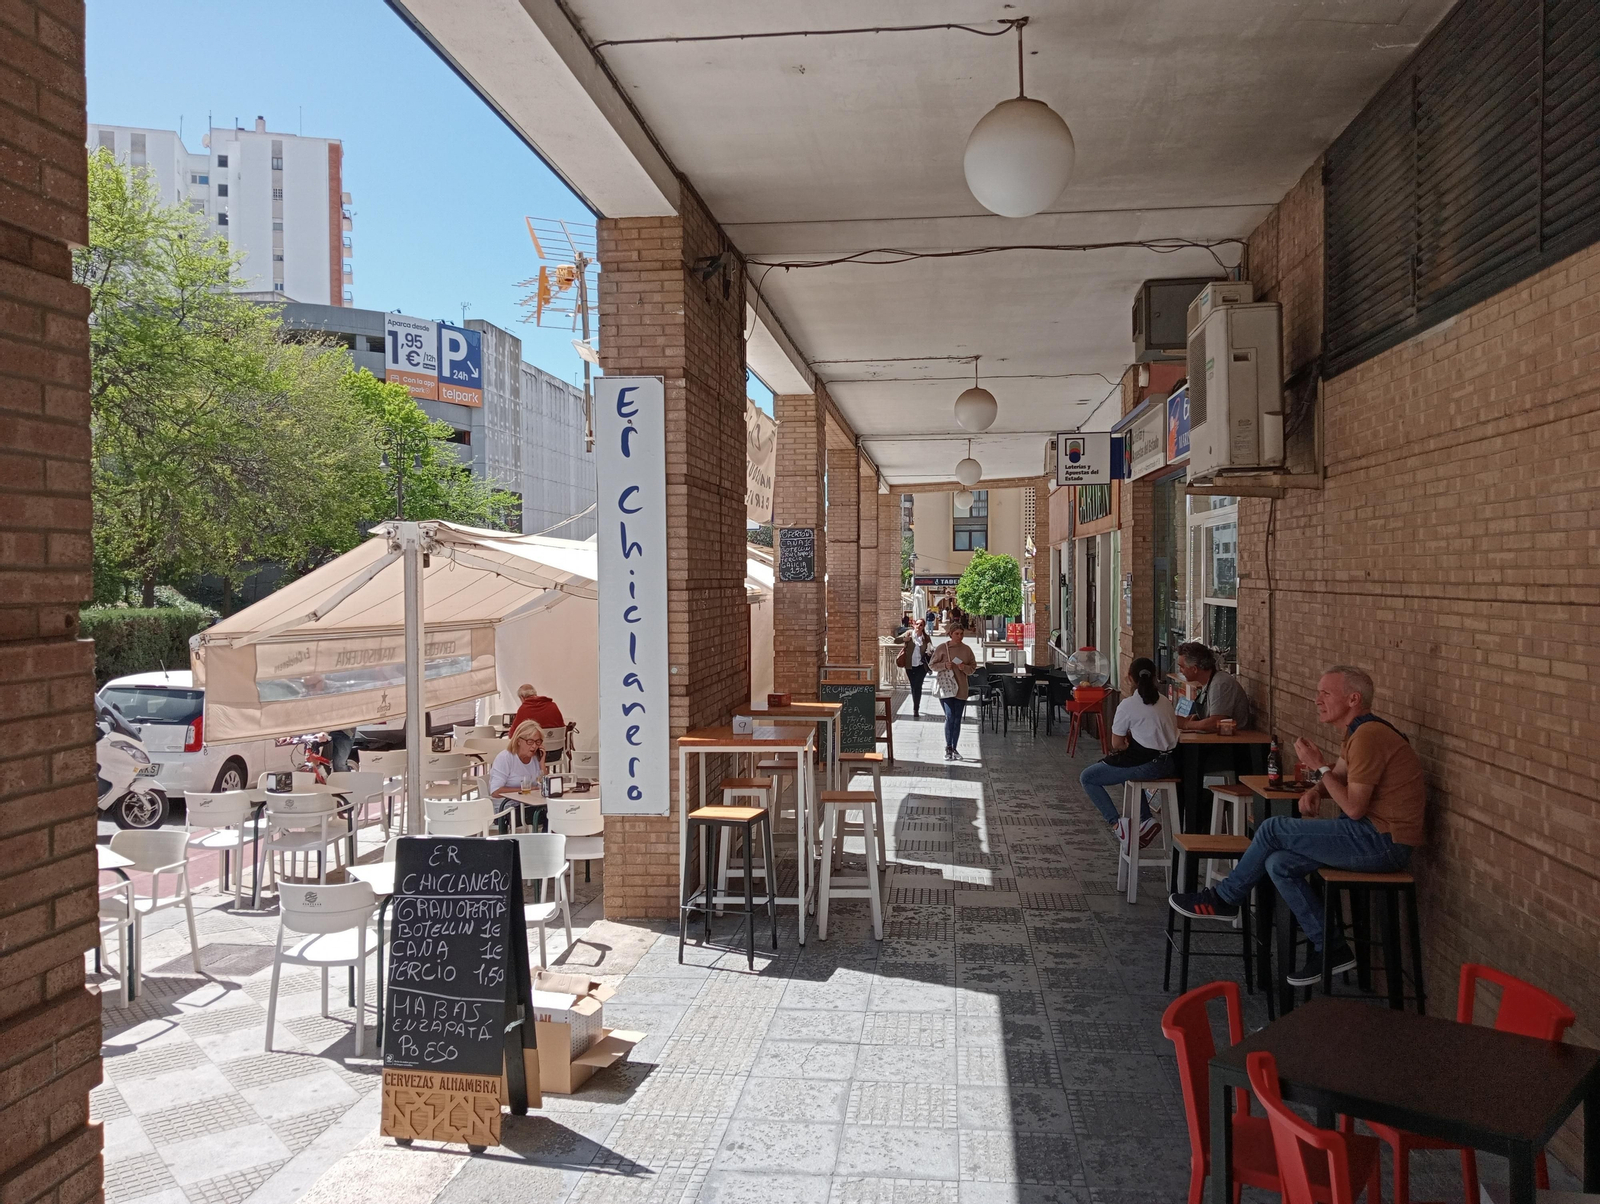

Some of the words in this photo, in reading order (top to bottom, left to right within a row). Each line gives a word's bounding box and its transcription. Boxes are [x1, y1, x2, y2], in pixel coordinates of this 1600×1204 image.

[387, 319, 411, 328] Aparca
[411, 323, 430, 332] desde
[441, 328, 468, 378] P
[402, 376, 416, 384] Con
[423, 380, 435, 388] app
[453, 370, 468, 381] 24h
[442, 387, 479, 404] telpark
[617, 485, 647, 801] Chiclanero
[738, 721, 746, 732] 9
[428, 844, 462, 867] ER
[402, 869, 511, 894] CHICLANERO
[397, 897, 453, 921] GRAN
[455, 900, 507, 919] OFERTA
[398, 920, 475, 938] BOTELLIN
[480, 920, 502, 938] 1€
[391, 938, 449, 960] CAÑA
[480, 941, 504, 960] 1€
[473, 963, 505, 987] 1,50
[393, 993, 482, 1023] HABAS
[424, 1041, 459, 1064] ESO
[384, 1072, 435, 1090] CERVEZAS
[439, 1076, 498, 1095] ALHAMBRA
